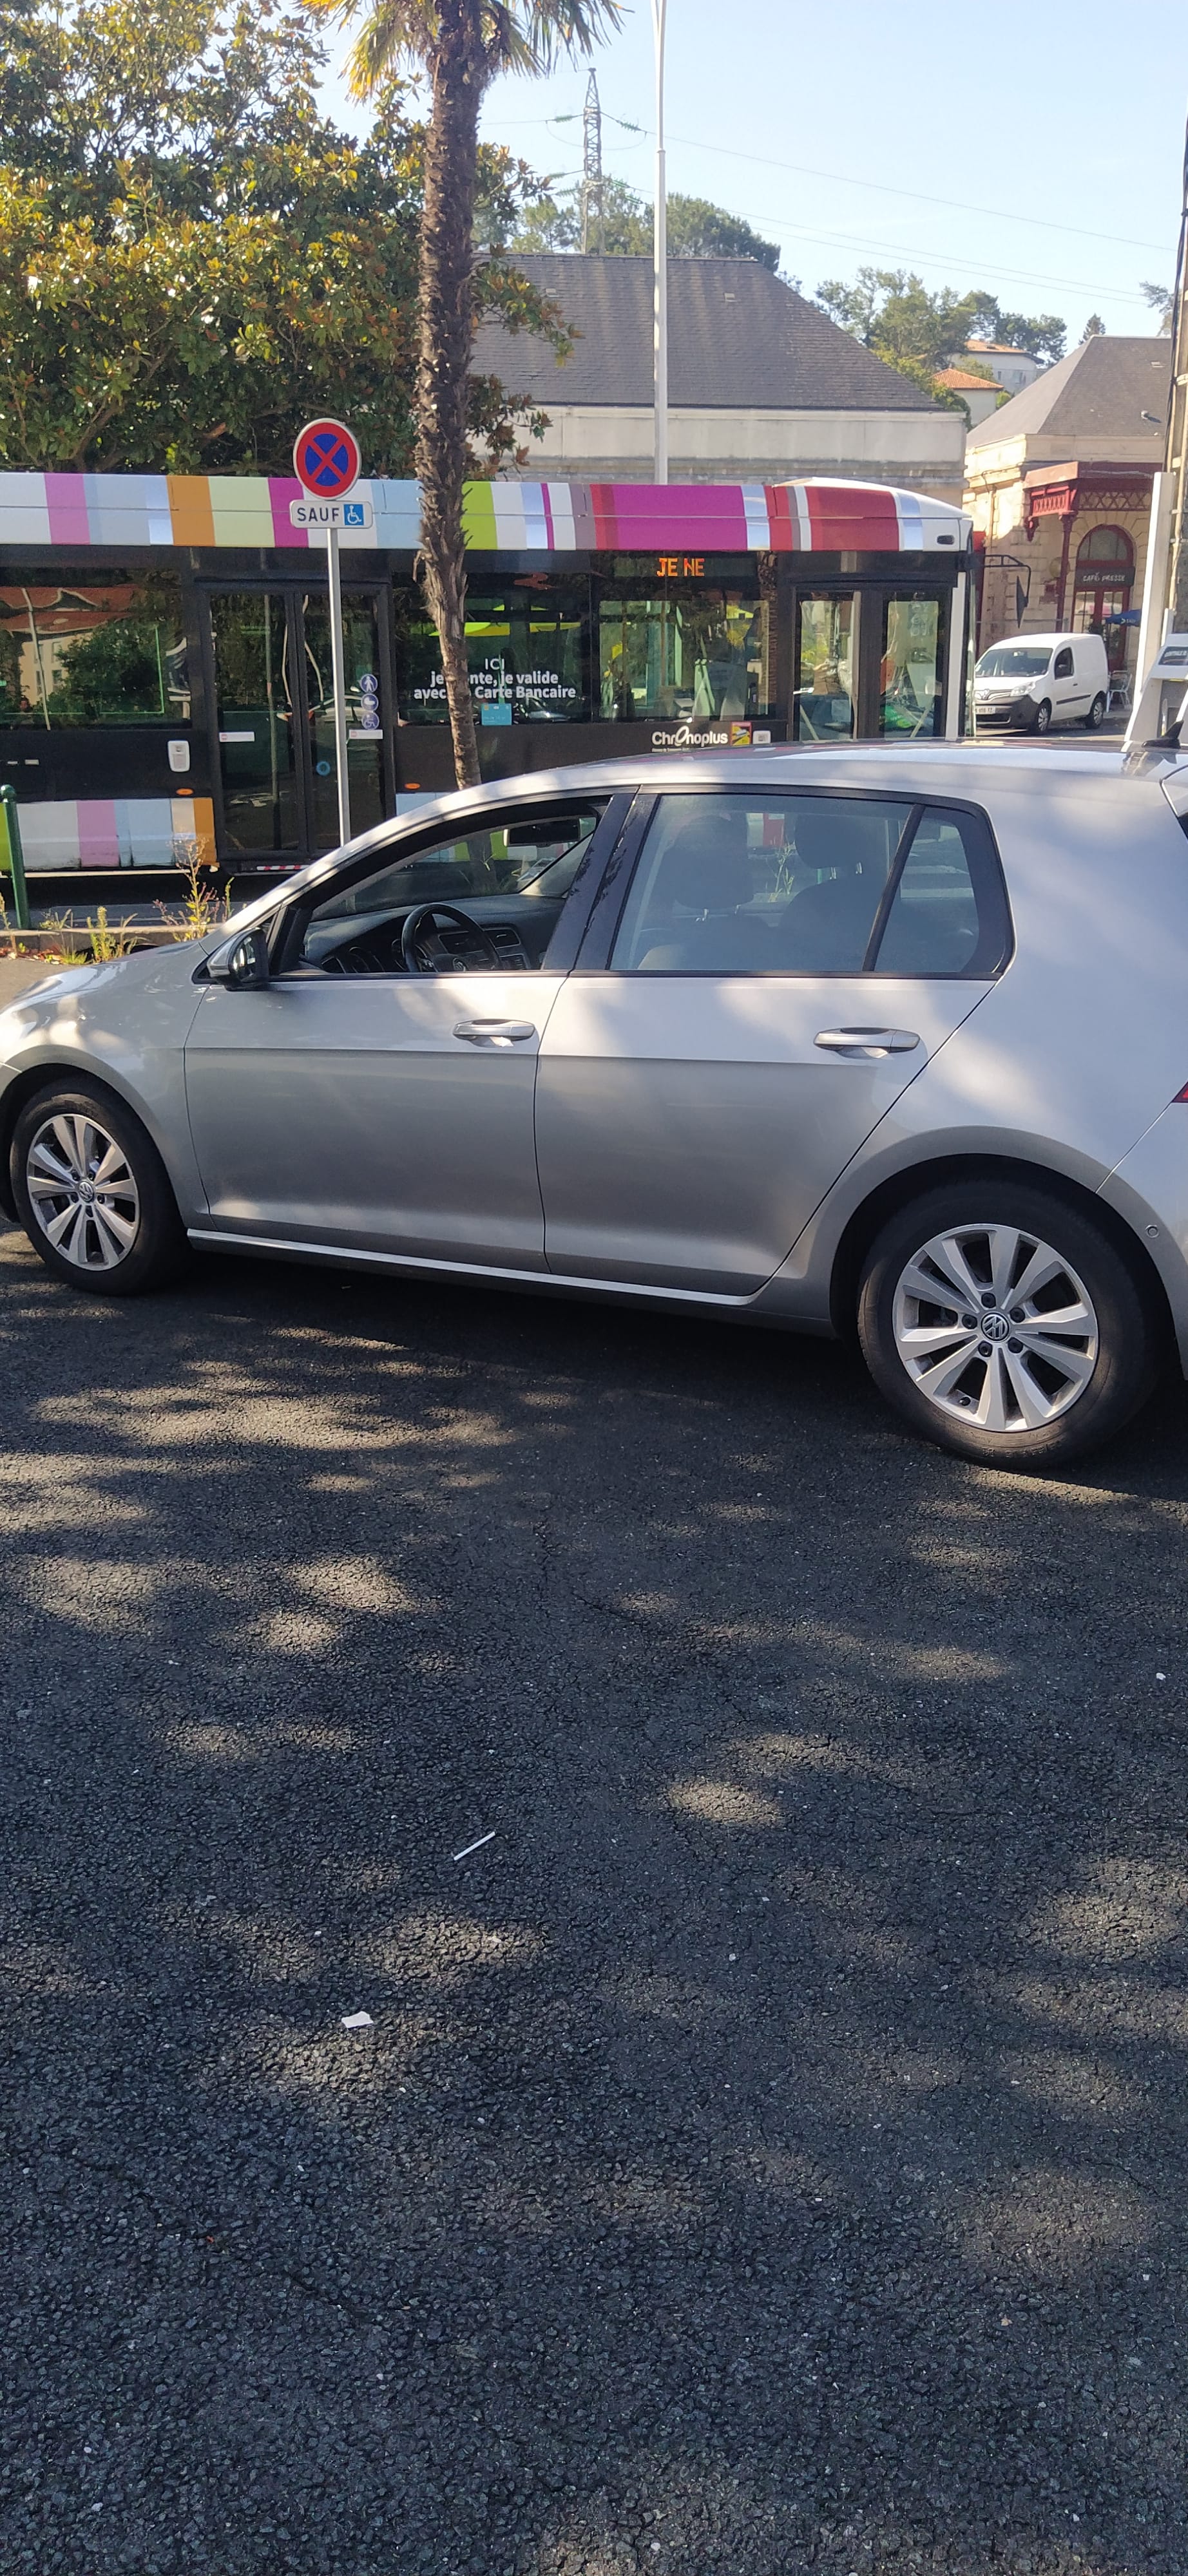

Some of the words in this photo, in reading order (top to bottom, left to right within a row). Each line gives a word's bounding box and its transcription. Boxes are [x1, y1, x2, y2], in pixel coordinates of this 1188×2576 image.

[297, 507, 340, 522] SAUF
[656, 558, 678, 576] JE
[684, 558, 705, 576] NE
[485, 658, 504, 670] ICI
[430, 670, 444, 688] je
[500, 670, 513, 687] je
[516, 670, 559, 684] valide
[414, 688, 446, 699] avec
[475, 686, 513, 699] Carte
[516, 685, 576, 698] Bancaire
